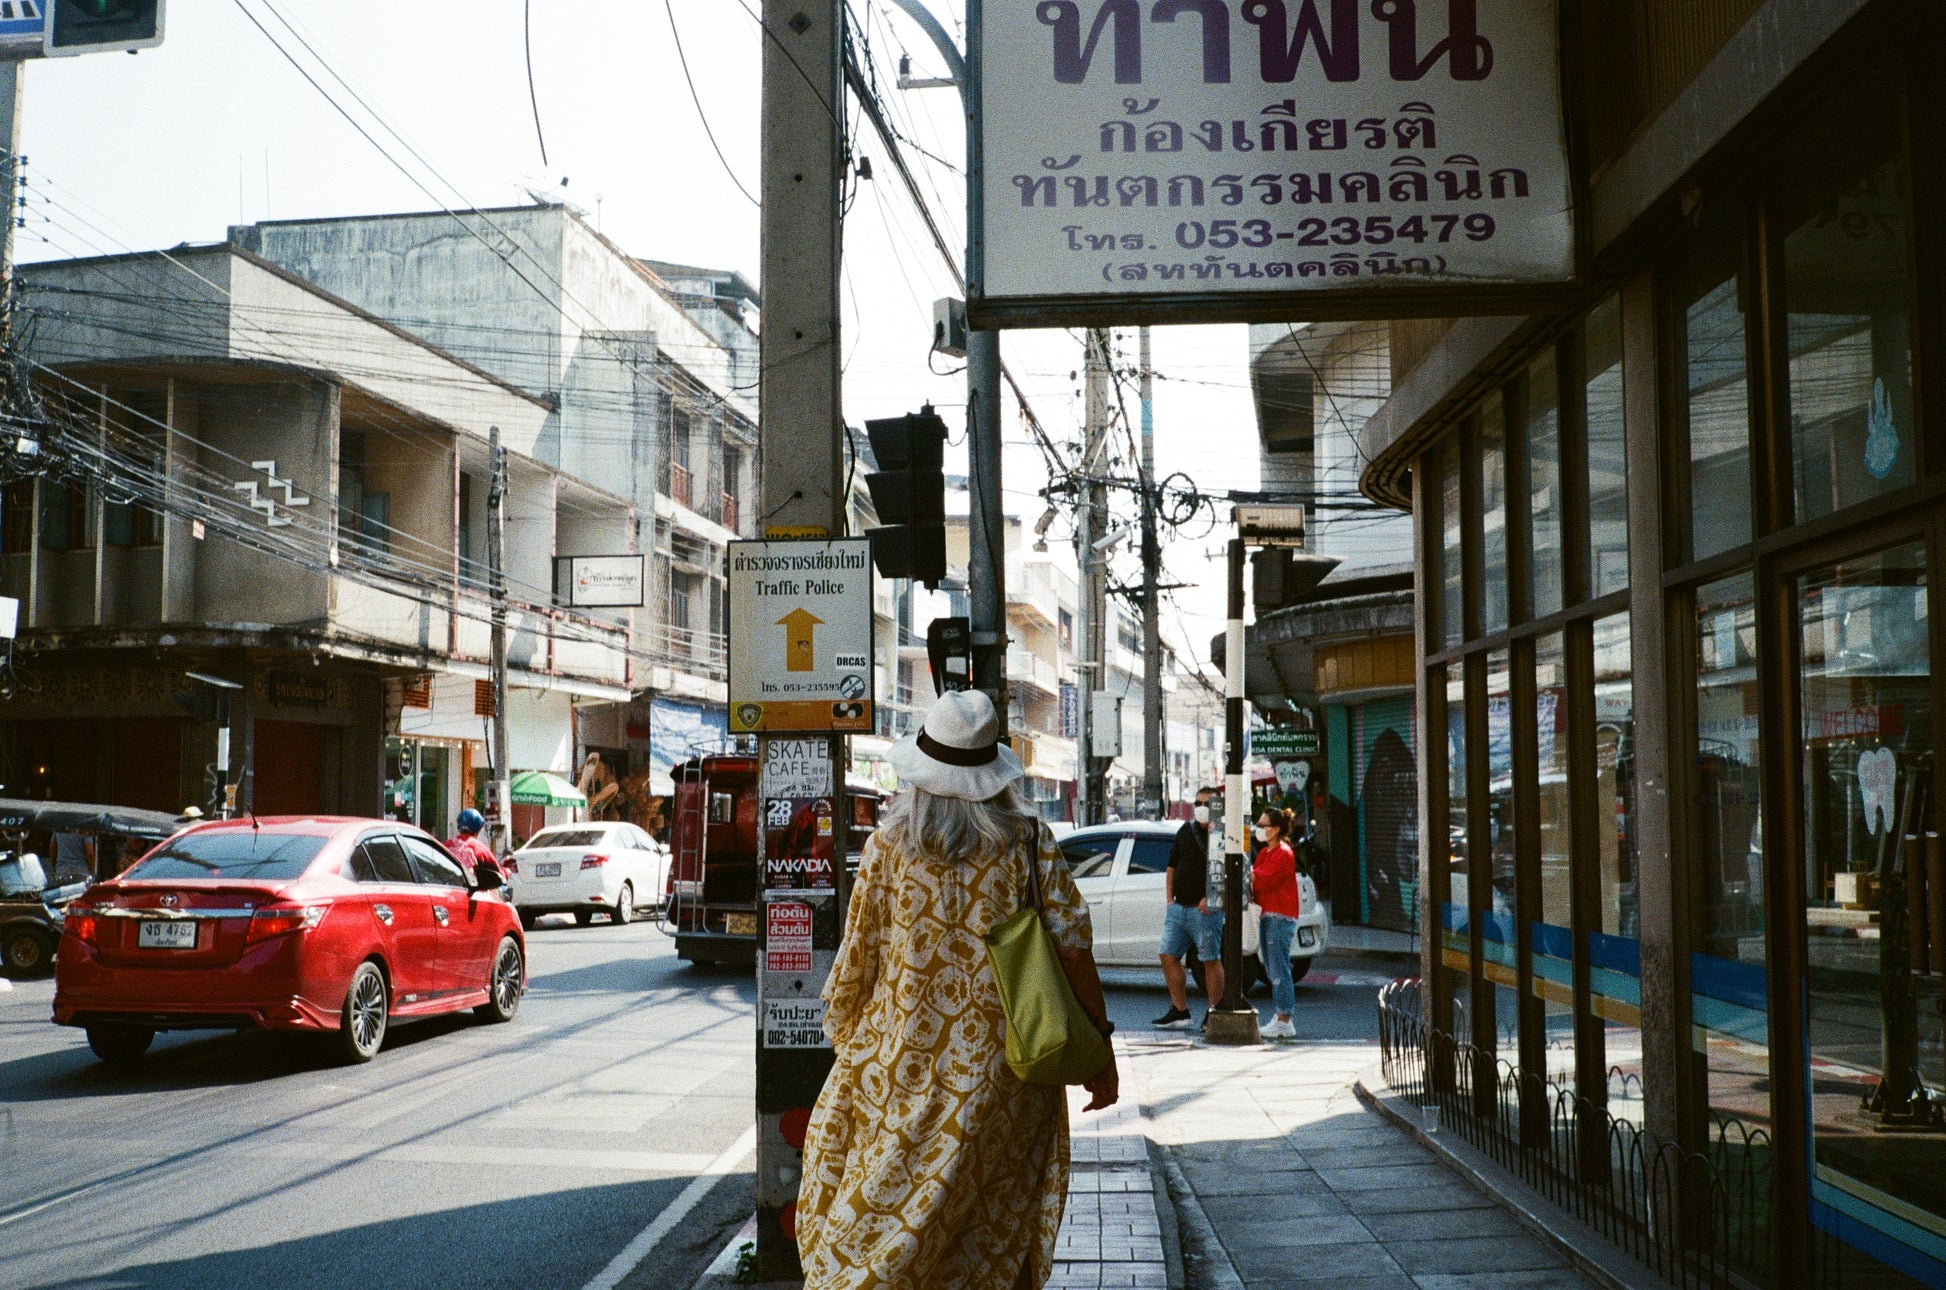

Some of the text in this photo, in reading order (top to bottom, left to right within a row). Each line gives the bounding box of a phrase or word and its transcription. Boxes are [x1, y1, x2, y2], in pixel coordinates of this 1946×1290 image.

[1100, 98, 1436, 154] ก้องเกียรติ
[1012, 154, 1530, 208] ทันตกรรมคลินิก
[1061, 213, 1496, 251] โทร. 053-235479
[756, 579, 845, 596] Traffic Police
[1819, 703, 1905, 738] WELCOME
[768, 740, 827, 760] SKATE
[768, 761, 809, 776] CAFE
[767, 799, 792, 816] 28
[767, 814, 790, 826] FEB
[767, 858, 832, 873] NAKADIA
